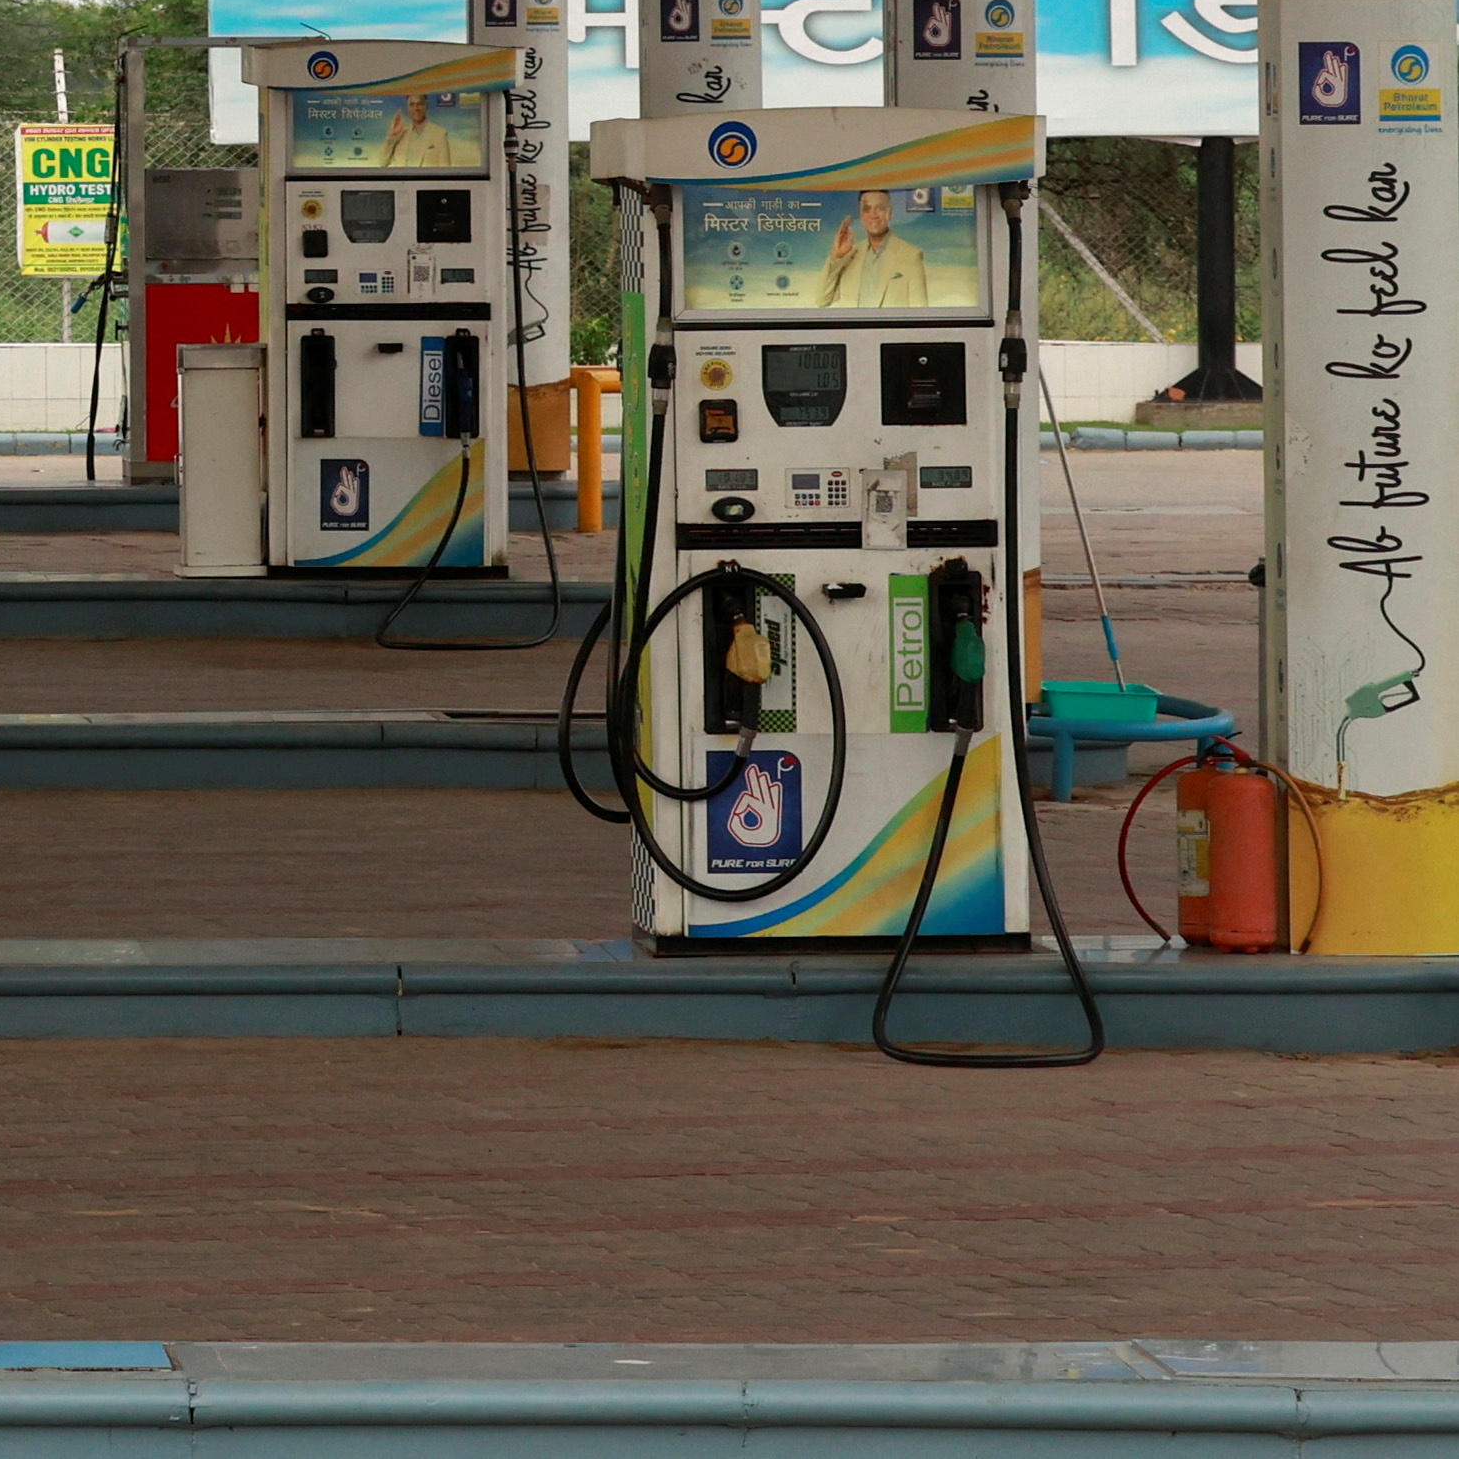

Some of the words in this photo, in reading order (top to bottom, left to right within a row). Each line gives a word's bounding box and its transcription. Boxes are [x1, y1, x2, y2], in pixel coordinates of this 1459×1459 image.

[676, 62, 729, 106] kar
[1383, 102, 1437, 111] Petroleum
[1393, 93, 1428, 102] Bharat
[1378, 127, 1422, 135] energising
[1424, 125, 1443, 133] lives
[32, 147, 111, 179] CNG
[30, 184, 76, 196] HYDRO
[79, 184, 112, 196] TEST
[1322, 160, 1411, 225] kar
[725, 197, 756, 211] आपकी
[761, 198, 783, 213] गाड़ी
[787, 199, 801, 211] का
[702, 213, 750, 233] मिस्टर
[1320, 240, 1426, 317] feel
[797, 353, 839, 370] 100.00
[1324, 334, 1413, 380] ko
[421, 351, 443, 422] Diesel
[816, 372, 840, 389] 1.05
[1338, 397, 1429, 509] future
[1327, 527, 1422, 582] Ab
[895, 602, 924, 707] Petrol
[711, 858, 743, 869] PURE
[745, 860, 764, 869] FOR
